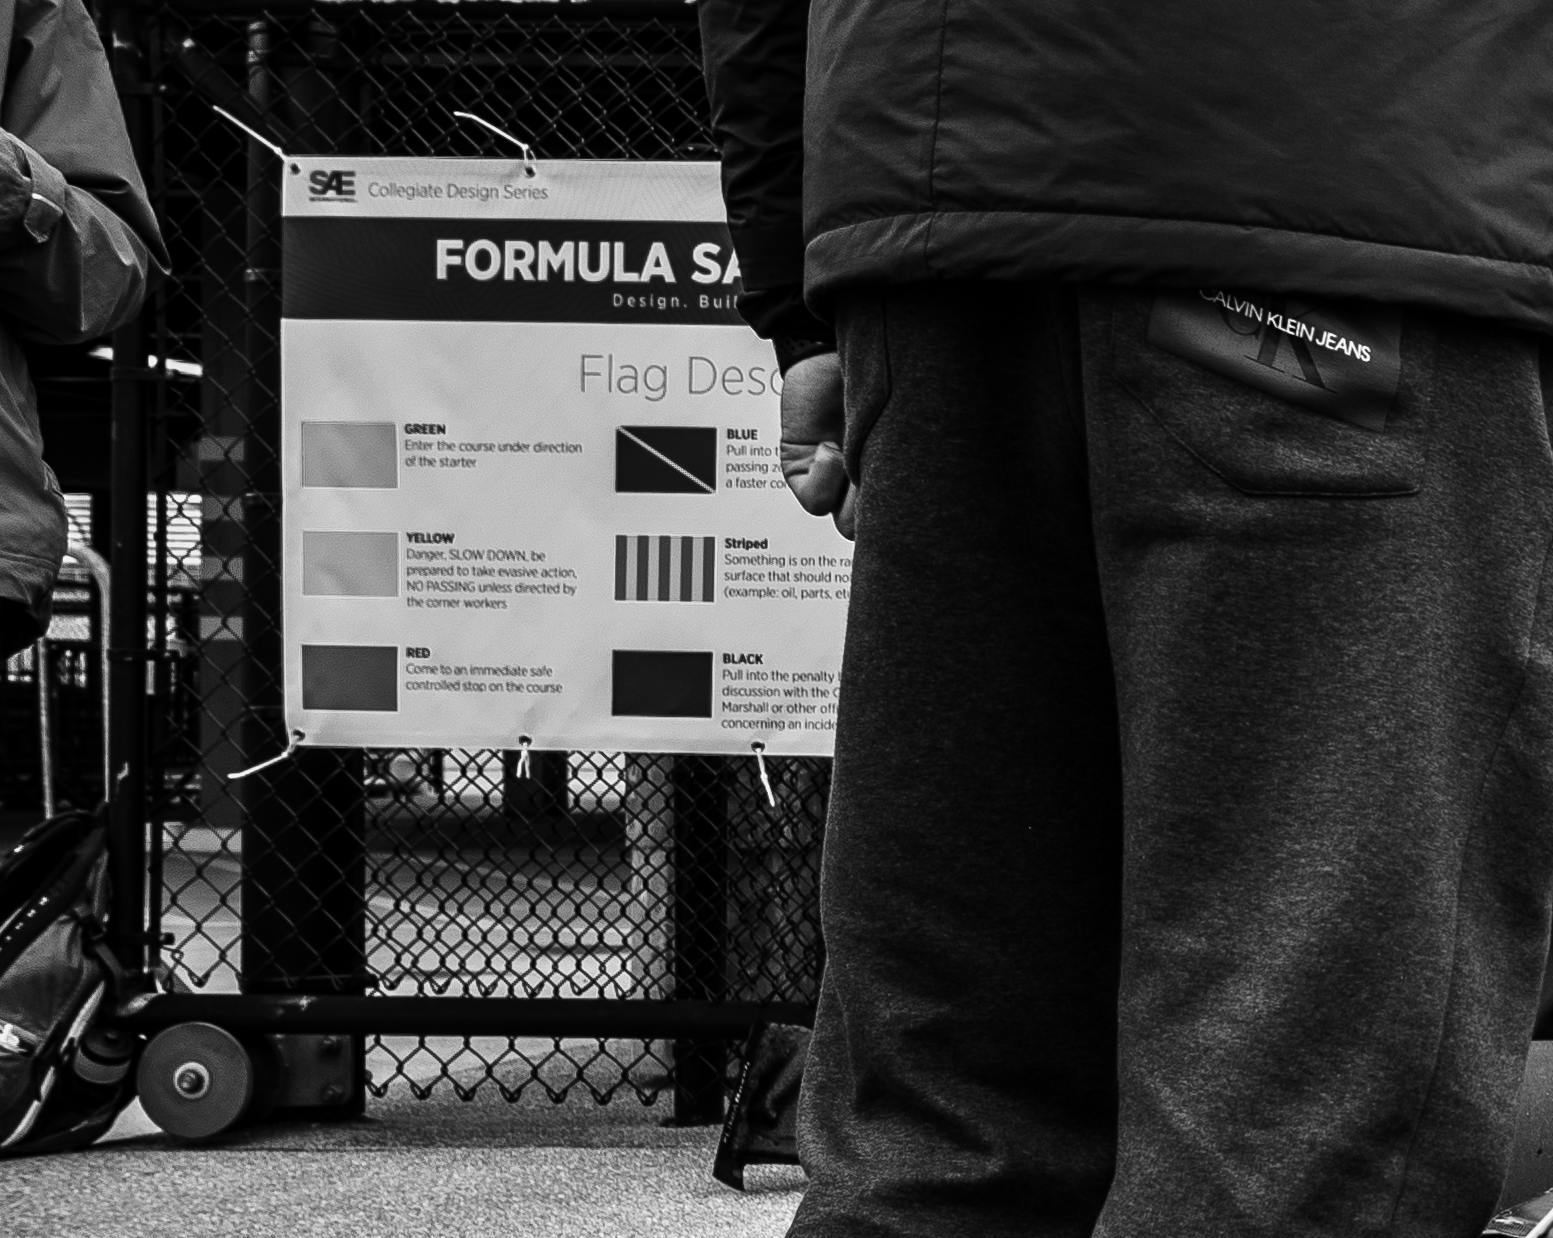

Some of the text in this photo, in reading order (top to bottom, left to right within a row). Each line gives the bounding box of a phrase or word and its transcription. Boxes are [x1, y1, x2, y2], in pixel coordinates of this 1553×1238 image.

[308, 169, 356, 197] SAE
[367, 181, 549, 203] Collegiate Design Series
[437, 239, 742, 286] FORMULA SA
[612, 292, 738, 311] Design. Buil
[1199, 288, 1372, 363] CALVIN KLEIN JEANS
[579, 353, 782, 402] Flag Desc
[404, 423, 446, 435] GREEN
[726, 428, 758, 441] BLUE
[405, 439, 583, 454] Enter the course under direction
[726, 444, 748, 456] Pull
[750, 445, 773, 457] into
[405, 455, 477, 469] of the starter
[726, 461, 769, 475] passing
[726, 479, 733, 489] a
[735, 477, 767, 490] faster
[406, 532, 455, 545] YELLOW
[724, 537, 768, 551] Striped
[450, 550, 484, 562] SLOW
[531, 551, 546, 562] be
[724, 554, 851, 568] Something is on the ra
[406, 566, 455, 579] prepared
[456, 566, 469, 577] to
[471, 566, 496, 578] take
[498, 567, 538, 579] evasive
[724, 570, 850, 583] surface that should no
[406, 581, 577, 597] NO PASSING unless directed by
[723, 586, 780, 600] (example:
[835, 588, 847, 600] et
[407, 597, 508, 610] the corner workers
[405, 647, 431, 659] RED
[722, 653, 764, 666] BLACK
[405, 664, 553, 677] Come to an immediate safe
[722, 670, 743, 682] Pull
[746, 670, 769, 682] into
[771, 670, 790, 683] the
[792, 671, 835, 685] penalty
[405, 680, 563, 694] controlled stop on the course
[722, 685, 781, 698] discussion
[783, 686, 809, 699] with
[810, 687, 830, 699] the
[722, 701, 836, 715] Marshall or other off
[721, 718, 786, 732] concerning
[788, 720, 803, 731] an
